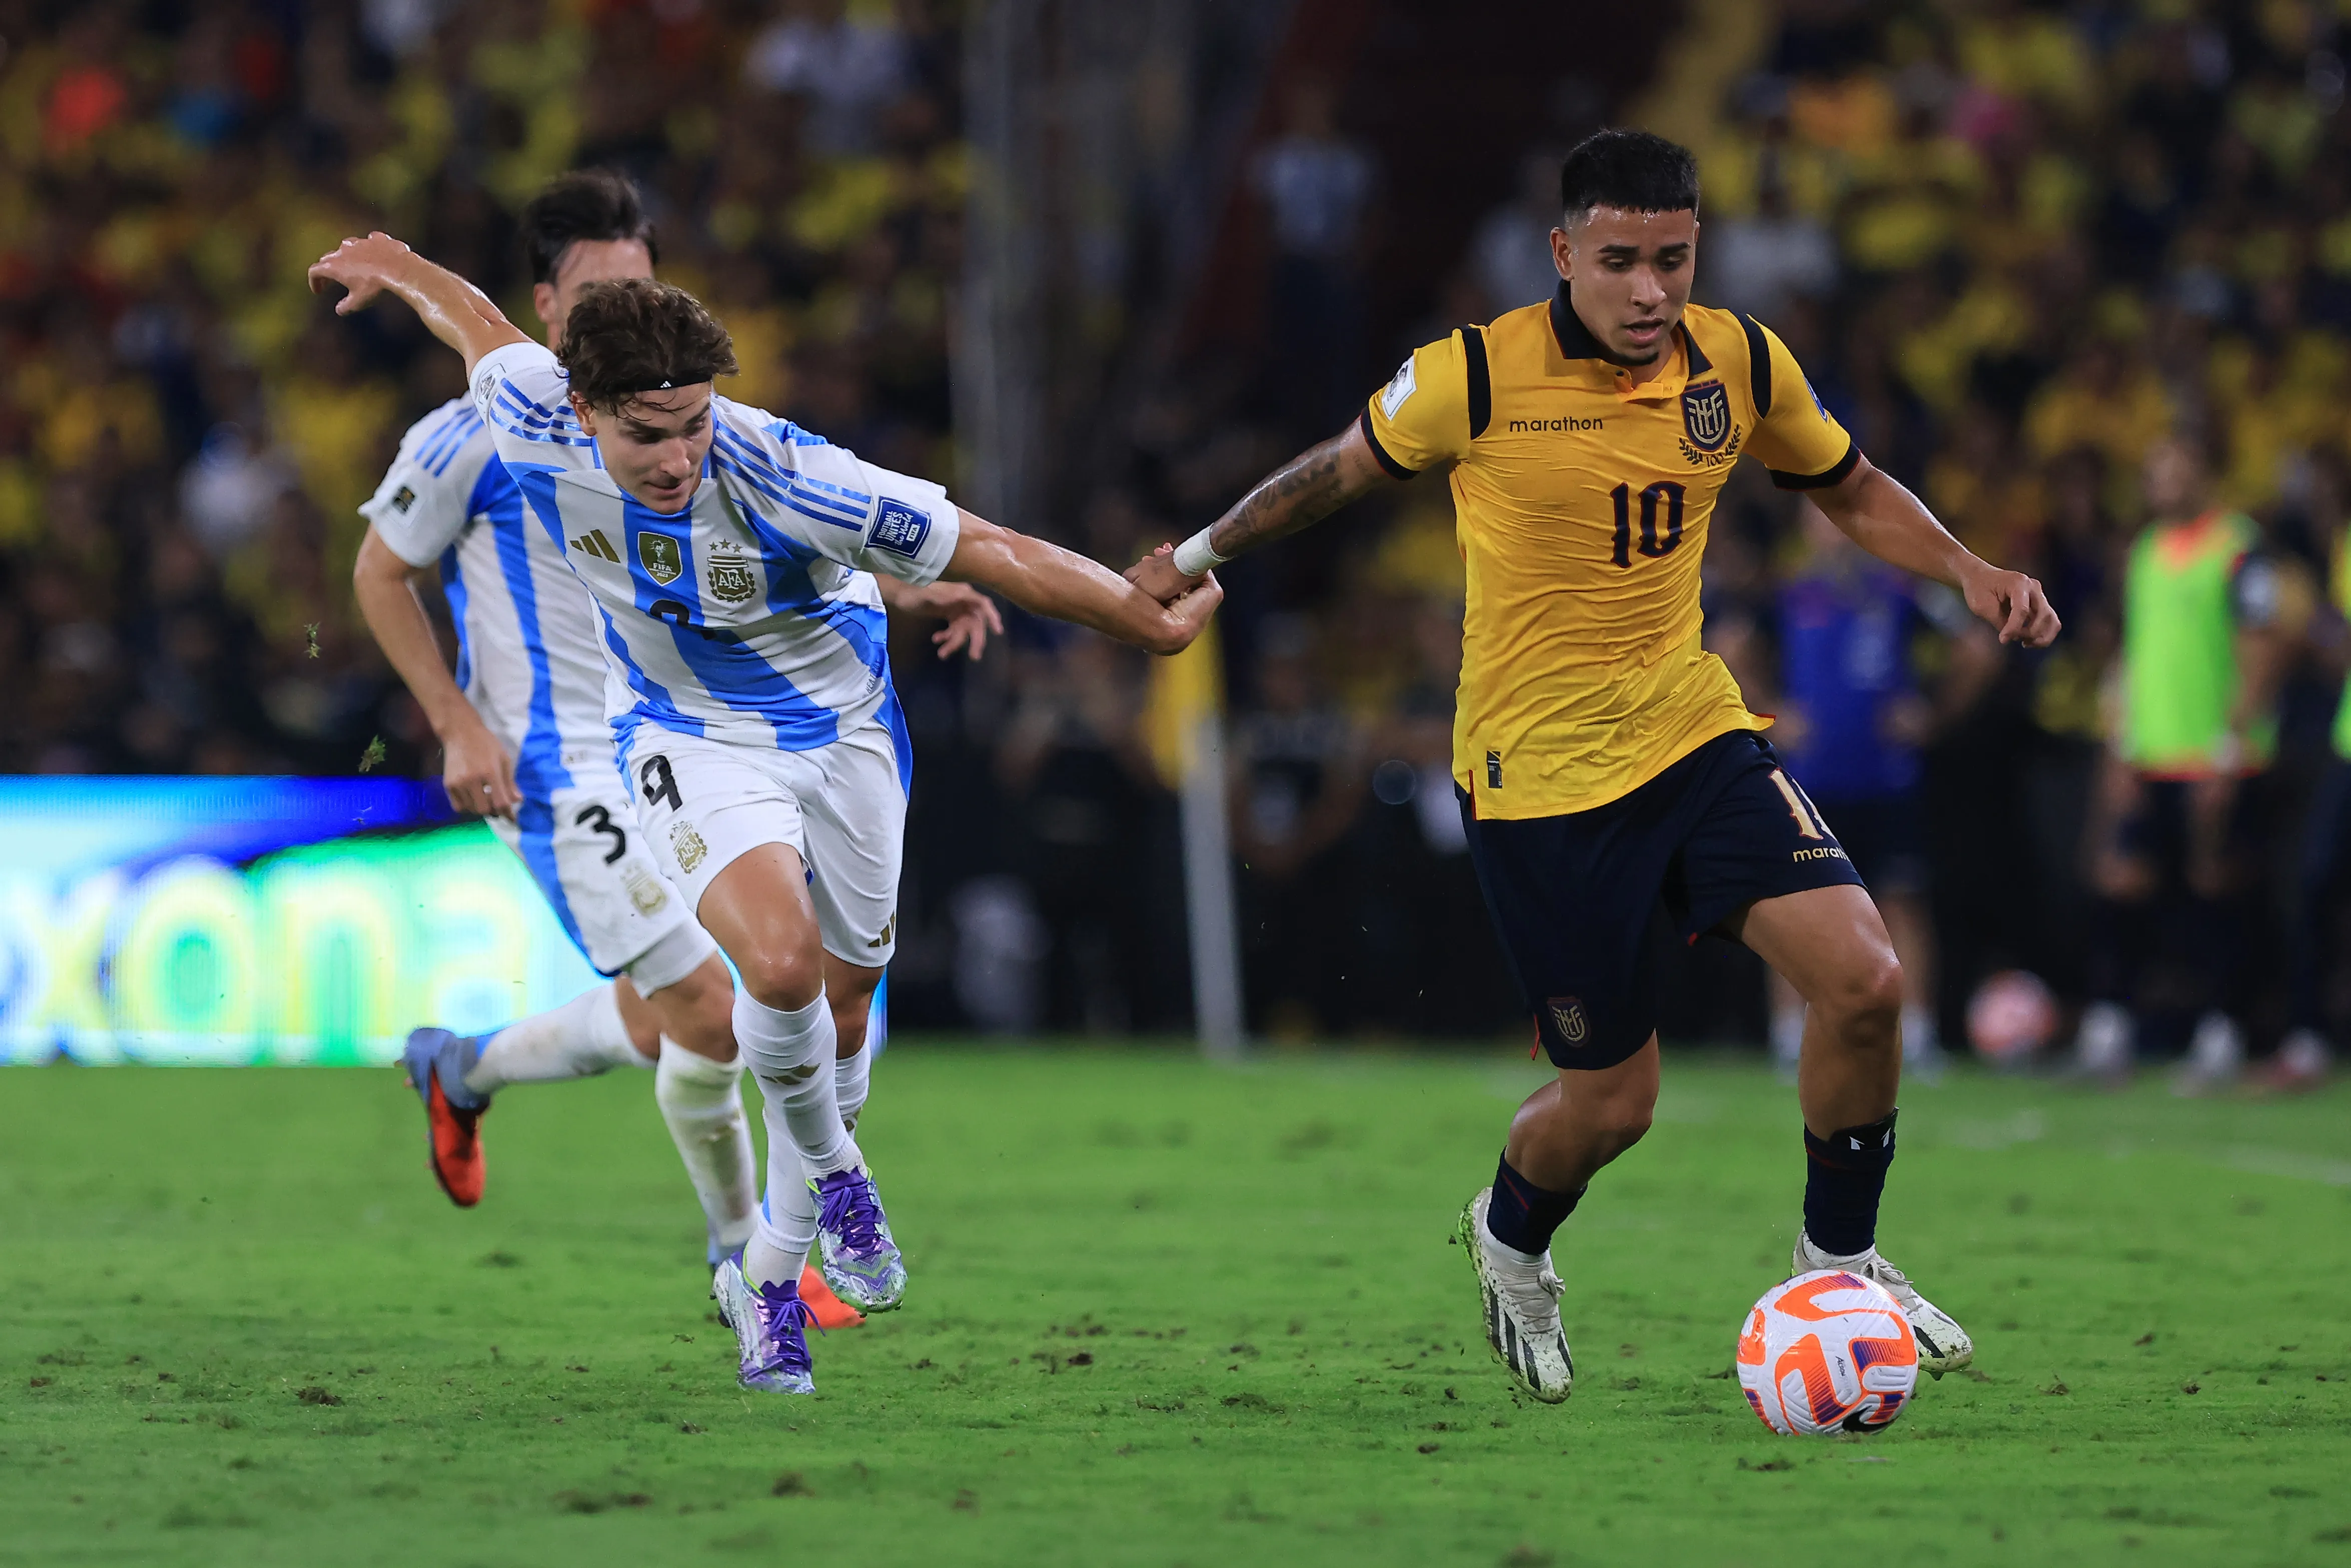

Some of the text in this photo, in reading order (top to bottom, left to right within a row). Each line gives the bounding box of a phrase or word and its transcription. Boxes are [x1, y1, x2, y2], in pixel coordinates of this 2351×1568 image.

[1509, 416, 1603, 432] marathon
[877, 511, 893, 539] FOOTBALL
[884, 512, 903, 541] UNITES
[909, 526, 918, 540] FIFA
[1610, 480, 1687, 569] 10
[653, 562, 672, 571] FIFA
[717, 568, 746, 590] AFA
[640, 754, 683, 813] 9
[575, 805, 625, 864] 3
